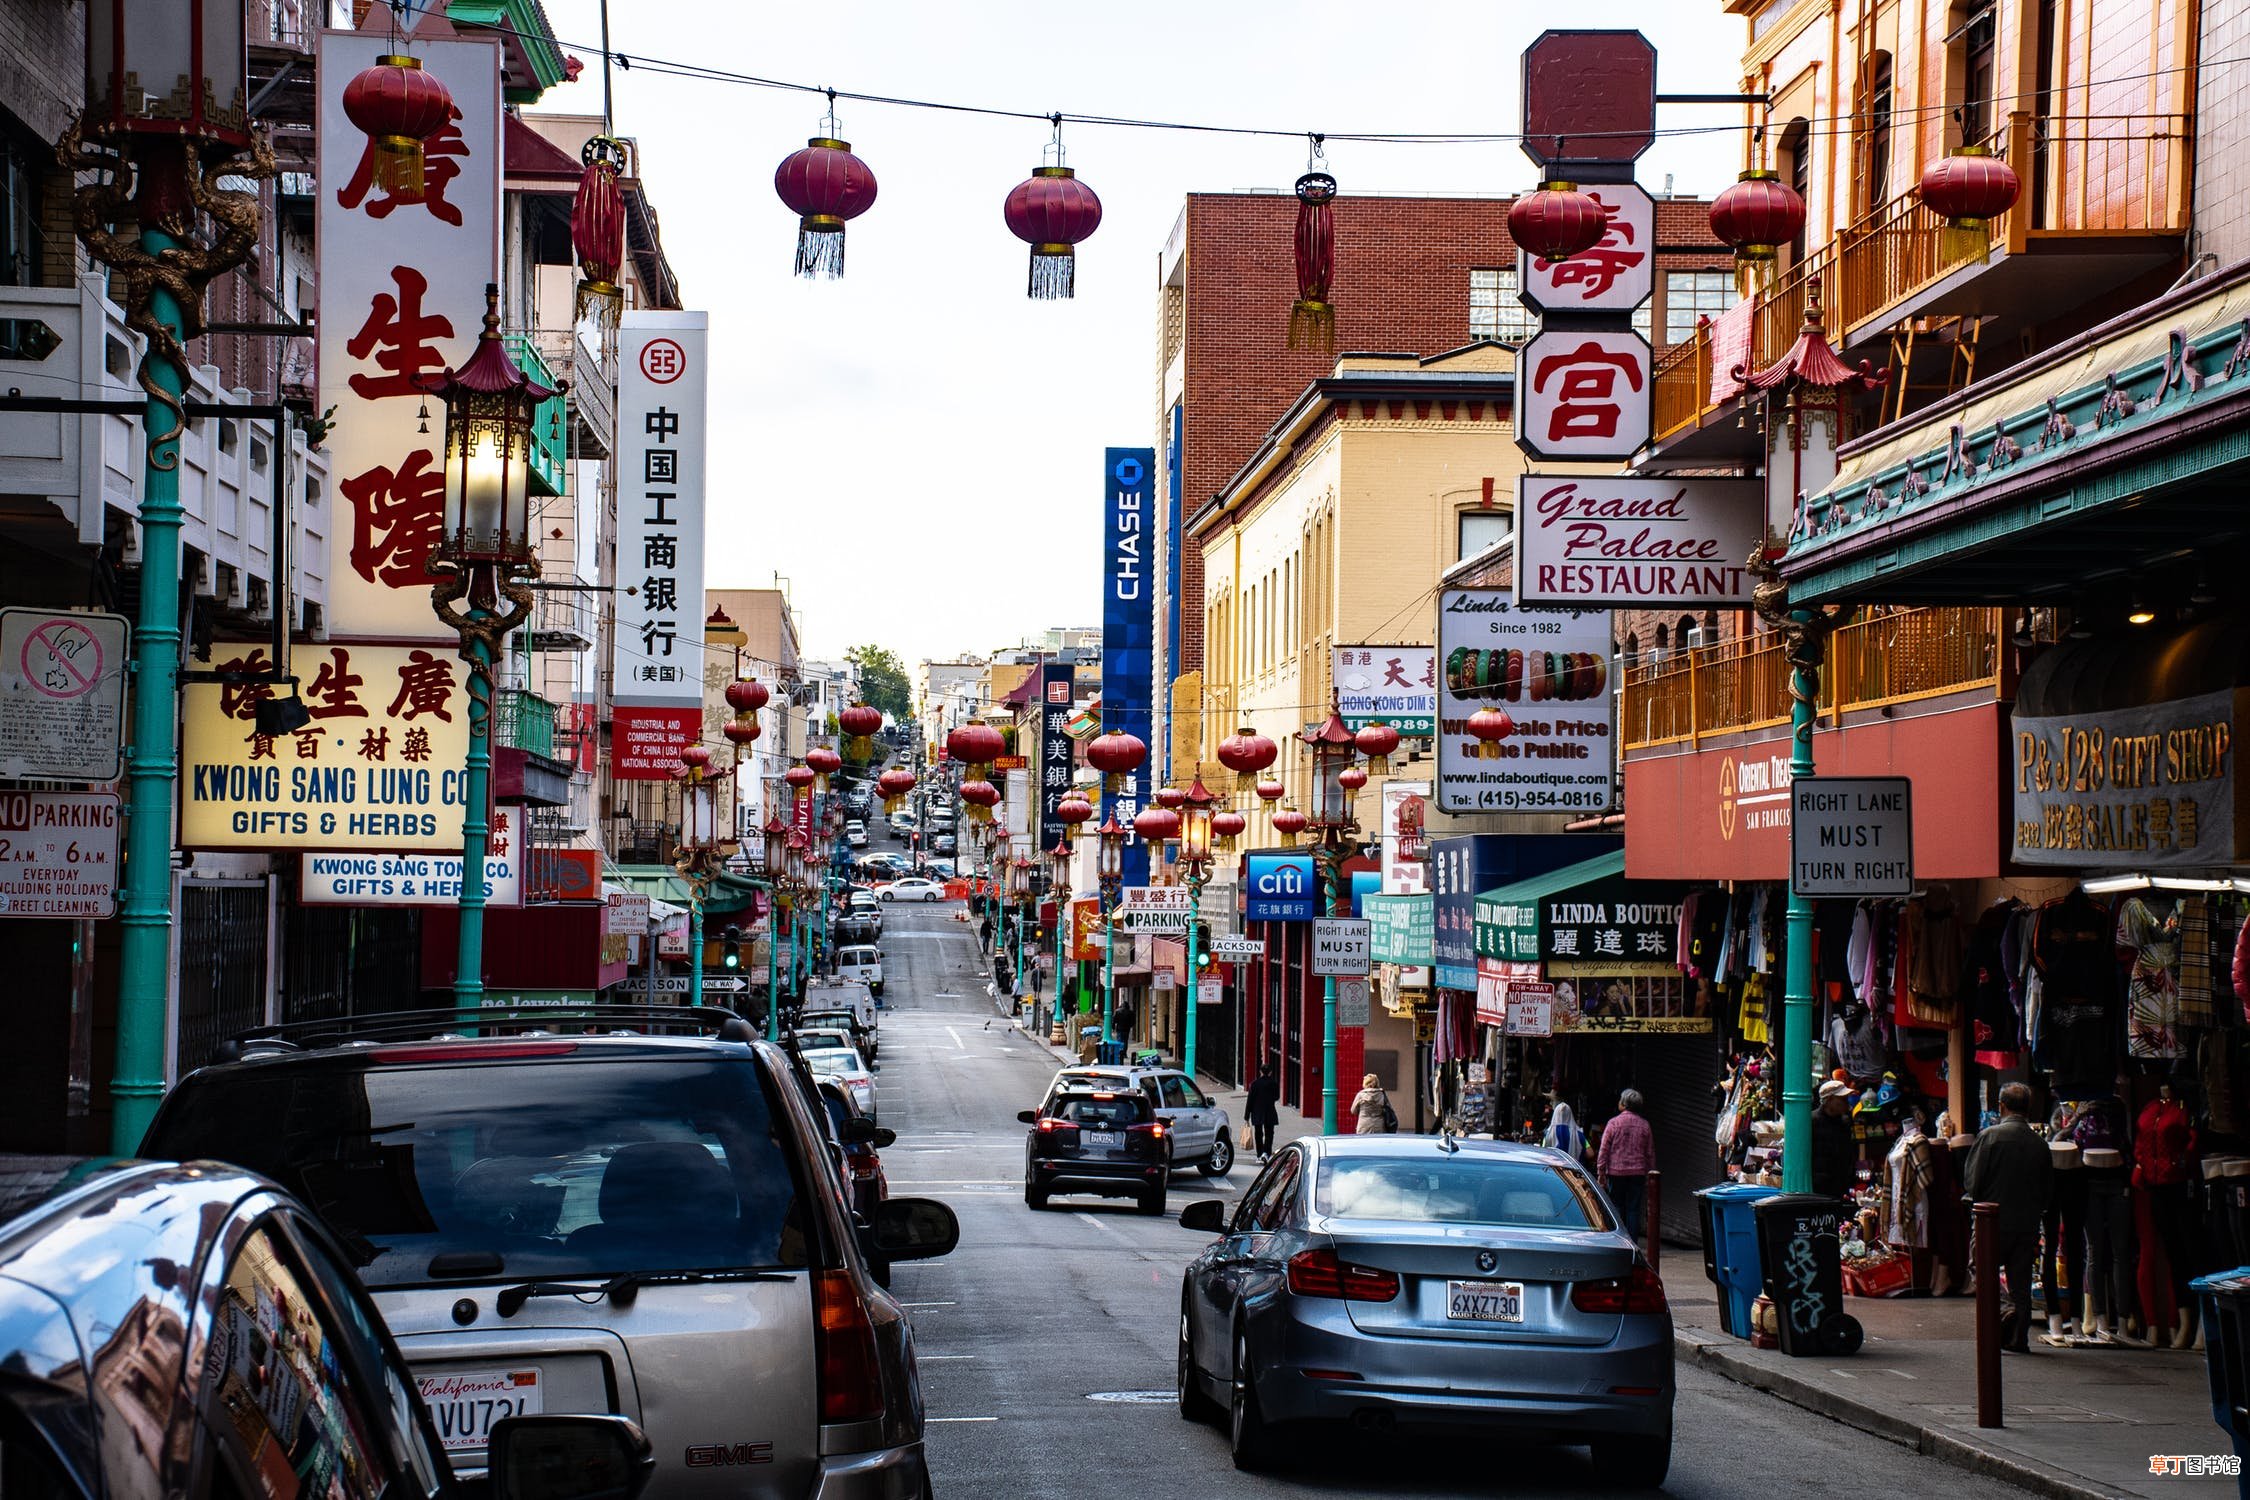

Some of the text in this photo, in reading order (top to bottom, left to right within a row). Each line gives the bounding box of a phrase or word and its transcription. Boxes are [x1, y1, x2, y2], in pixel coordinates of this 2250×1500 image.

[1537, 483, 1687, 528] Grand
[641, 406, 679, 656] 中国工商银行
[1117, 491, 1140, 600] CHASE
[1564, 523, 1719, 560] Palace
[1538, 564, 1745, 596] RESTAURANT
[1446, 594, 1509, 614] Linda
[1490, 622, 1562, 634] Since 1982
[1341, 651, 1372, 666] 香港
[1342, 695, 1371, 711] HONG
[1375, 695, 1404, 711] KONG
[1407, 696, 1426, 711] DIM
[631, 719, 680, 730] INDUSTRIAL AND
[1442, 718, 1609, 737] Wsale Price
[627, 732, 685, 743] COMMERCIAL BANK
[632, 744, 641, 755] OF
[1524, 743, 1588, 760] Public
[2110, 734, 2161, 789] GIFT
[2167, 721, 2230, 784] SHOP
[622, 757, 650, 769] NATIONAL
[1047, 712, 1069, 814] 華美銀行
[1443, 772, 1608, 787] www.lindaboutique.com
[1739, 756, 1793, 794] ORIENTAL TREAS
[194, 765, 280, 802] KWONG
[292, 767, 355, 803] SANG
[368, 768, 430, 805] LUNG
[1451, 790, 1604, 808] Tel: (415)-954-0816
[1800, 793, 1903, 812] RIGHT LANE
[34, 804, 114, 828] PARKING
[233, 811, 436, 836] GIFTS & HERBS
[1746, 808, 1791, 830] SAN FRANCIS
[1820, 825, 1882, 847] MUST
[2086, 803, 2148, 851] SALE
[14, 850, 38, 862] A.M.
[46, 844, 55, 852] TO
[66, 841, 80, 863] 6
[84, 852, 109, 864] A.M.
[23, 868, 79, 881] EVERYDAY
[313, 859, 513, 879] KWONG SANG TON CO.
[1800, 862, 1905, 880] TURN RIGHT
[0, 882, 108, 896] CLUDING HOLIDAYS
[333, 879, 494, 897] GIFTS & HERS
[1258, 868, 1302, 894] citi
[609, 894, 648, 906] NO PARKING
[1130, 889, 1187, 903] 豐盛行
[8, 900, 99, 913] TREET CLEANING
[1258, 904, 1305, 915] 花旗銀行
[1551, 904, 1607, 924] LINDA
[1135, 913, 1191, 927] PARKING
[1317, 926, 1368, 936] RIGHT LANE
[1209, 942, 1262, 951] JACKSON
[1320, 941, 1363, 953] MUST
[1551, 929, 1667, 956] 麗達珠
[1316, 957, 1368, 968] TURN RIGHT
[1511, 984, 1549, 992] TOW-AWAY
[1508, 992, 1551, 1004] NO STOPPING
[1521, 1006, 1539, 1015] ANY
[1520, 1017, 1538, 1026] TIME
[1452, 1294, 1518, 1315] 6XXZ730
[1475, 1313, 1520, 1322] CONCORD
[422, 1378, 514, 1400] California
[686, 1441, 773, 1467] GMC
